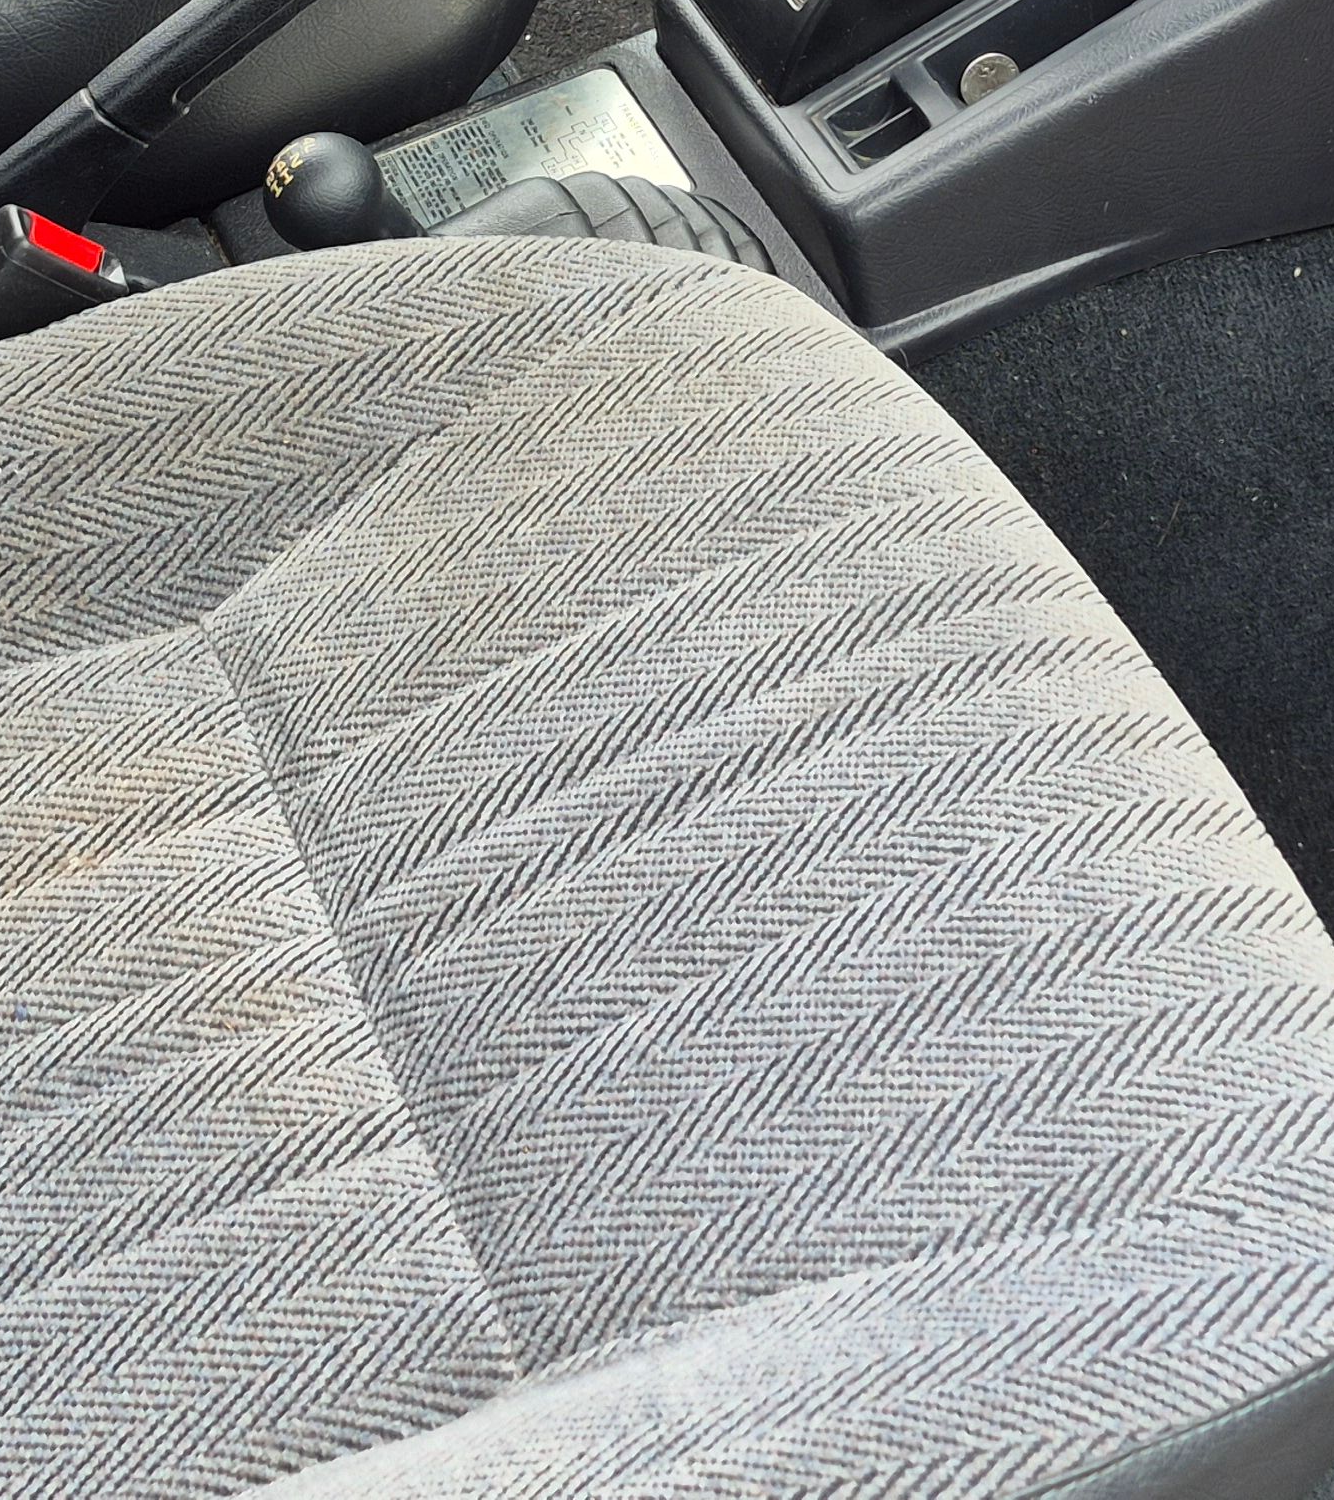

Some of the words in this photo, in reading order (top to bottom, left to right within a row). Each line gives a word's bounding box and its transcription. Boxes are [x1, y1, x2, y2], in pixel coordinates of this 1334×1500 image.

[618, 103, 647, 139] TRANSFER
[275, 160, 295, 186] 4H
[290, 152, 304, 169] N
[266, 171, 283, 198] 2H
